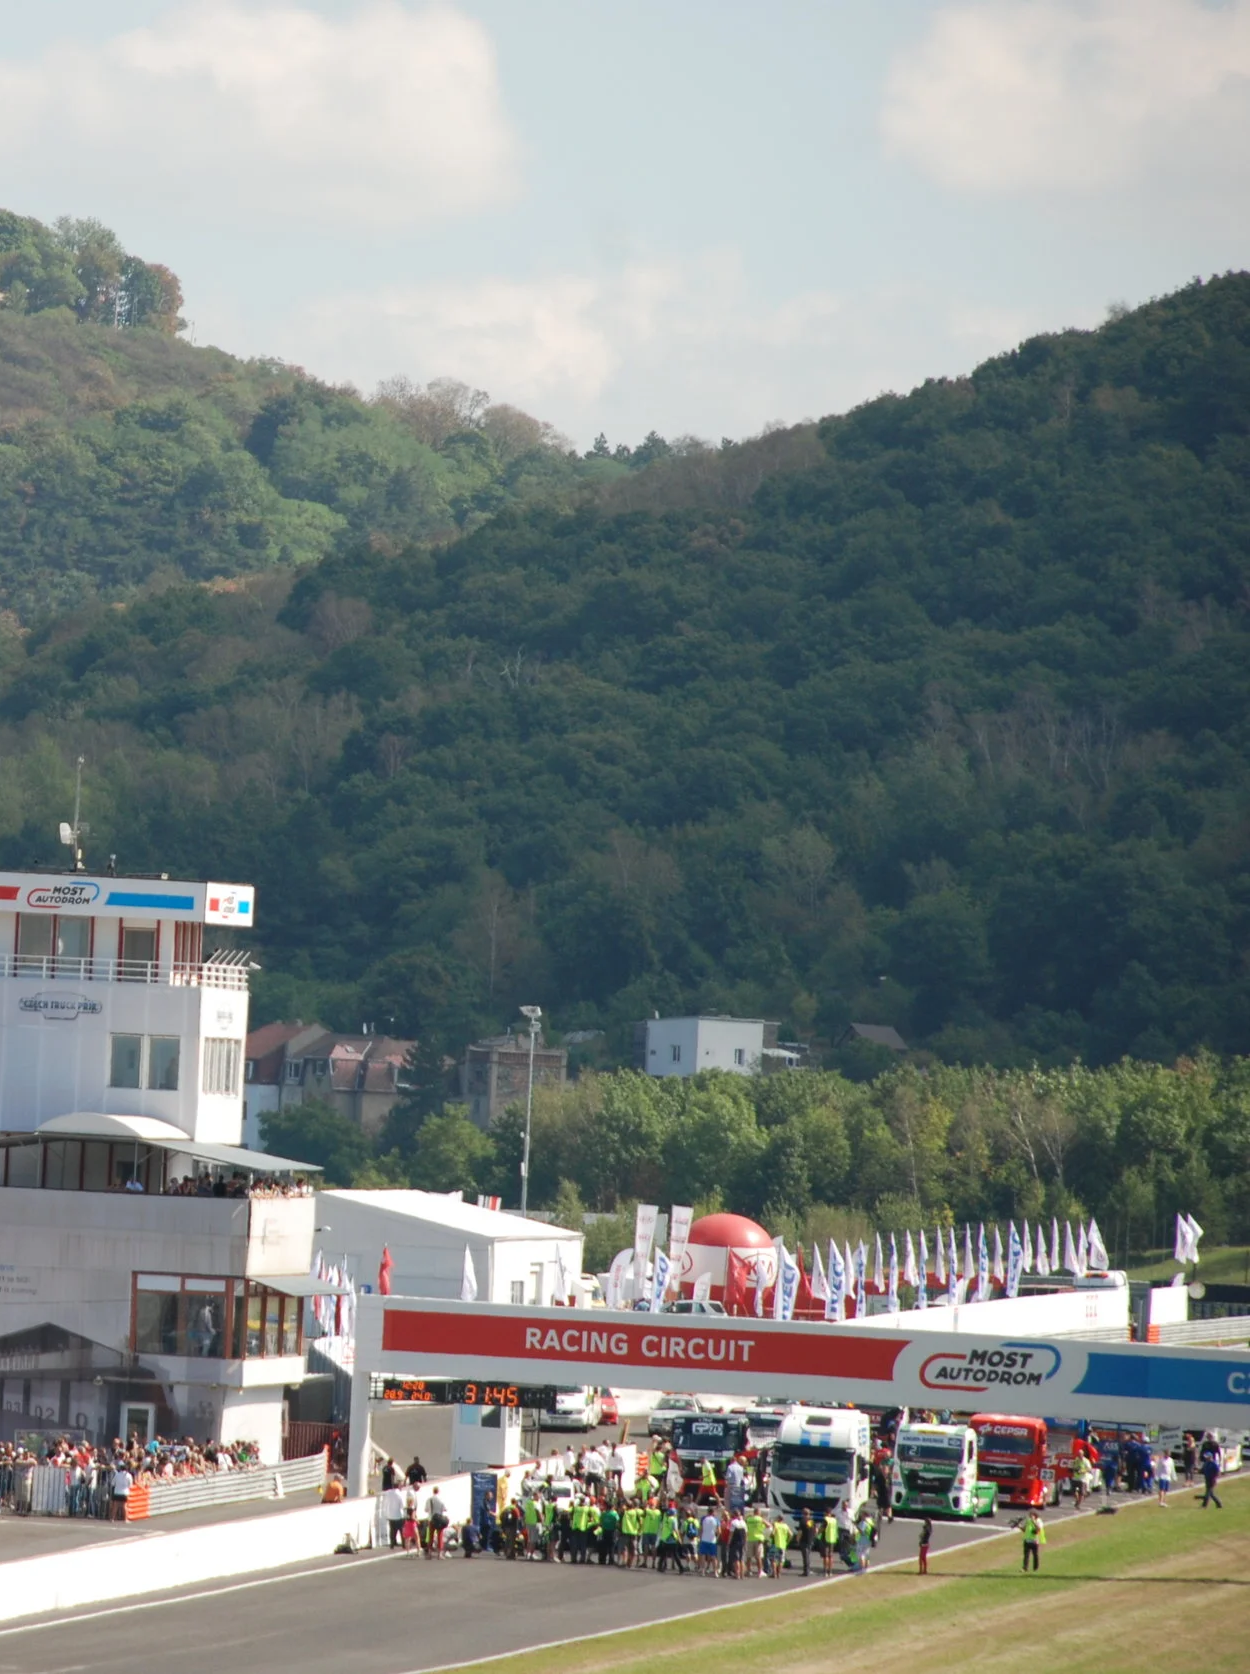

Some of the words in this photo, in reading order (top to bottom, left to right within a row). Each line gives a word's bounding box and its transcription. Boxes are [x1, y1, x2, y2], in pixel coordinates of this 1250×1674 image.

[52, 886, 86, 896] MOST
[35, 895, 91, 905] AUTODROM
[50, 1000, 76, 1010] TRUCK
[525, 1327, 628, 1356] RACING
[640, 1335, 756, 1363] CIRCUIT
[967, 1349, 1034, 1369] MOST
[934, 1366, 1043, 1386] AUTODROM
[1227, 1371, 1250, 1395] C
[993, 1425, 1029, 1436] CEPSA
